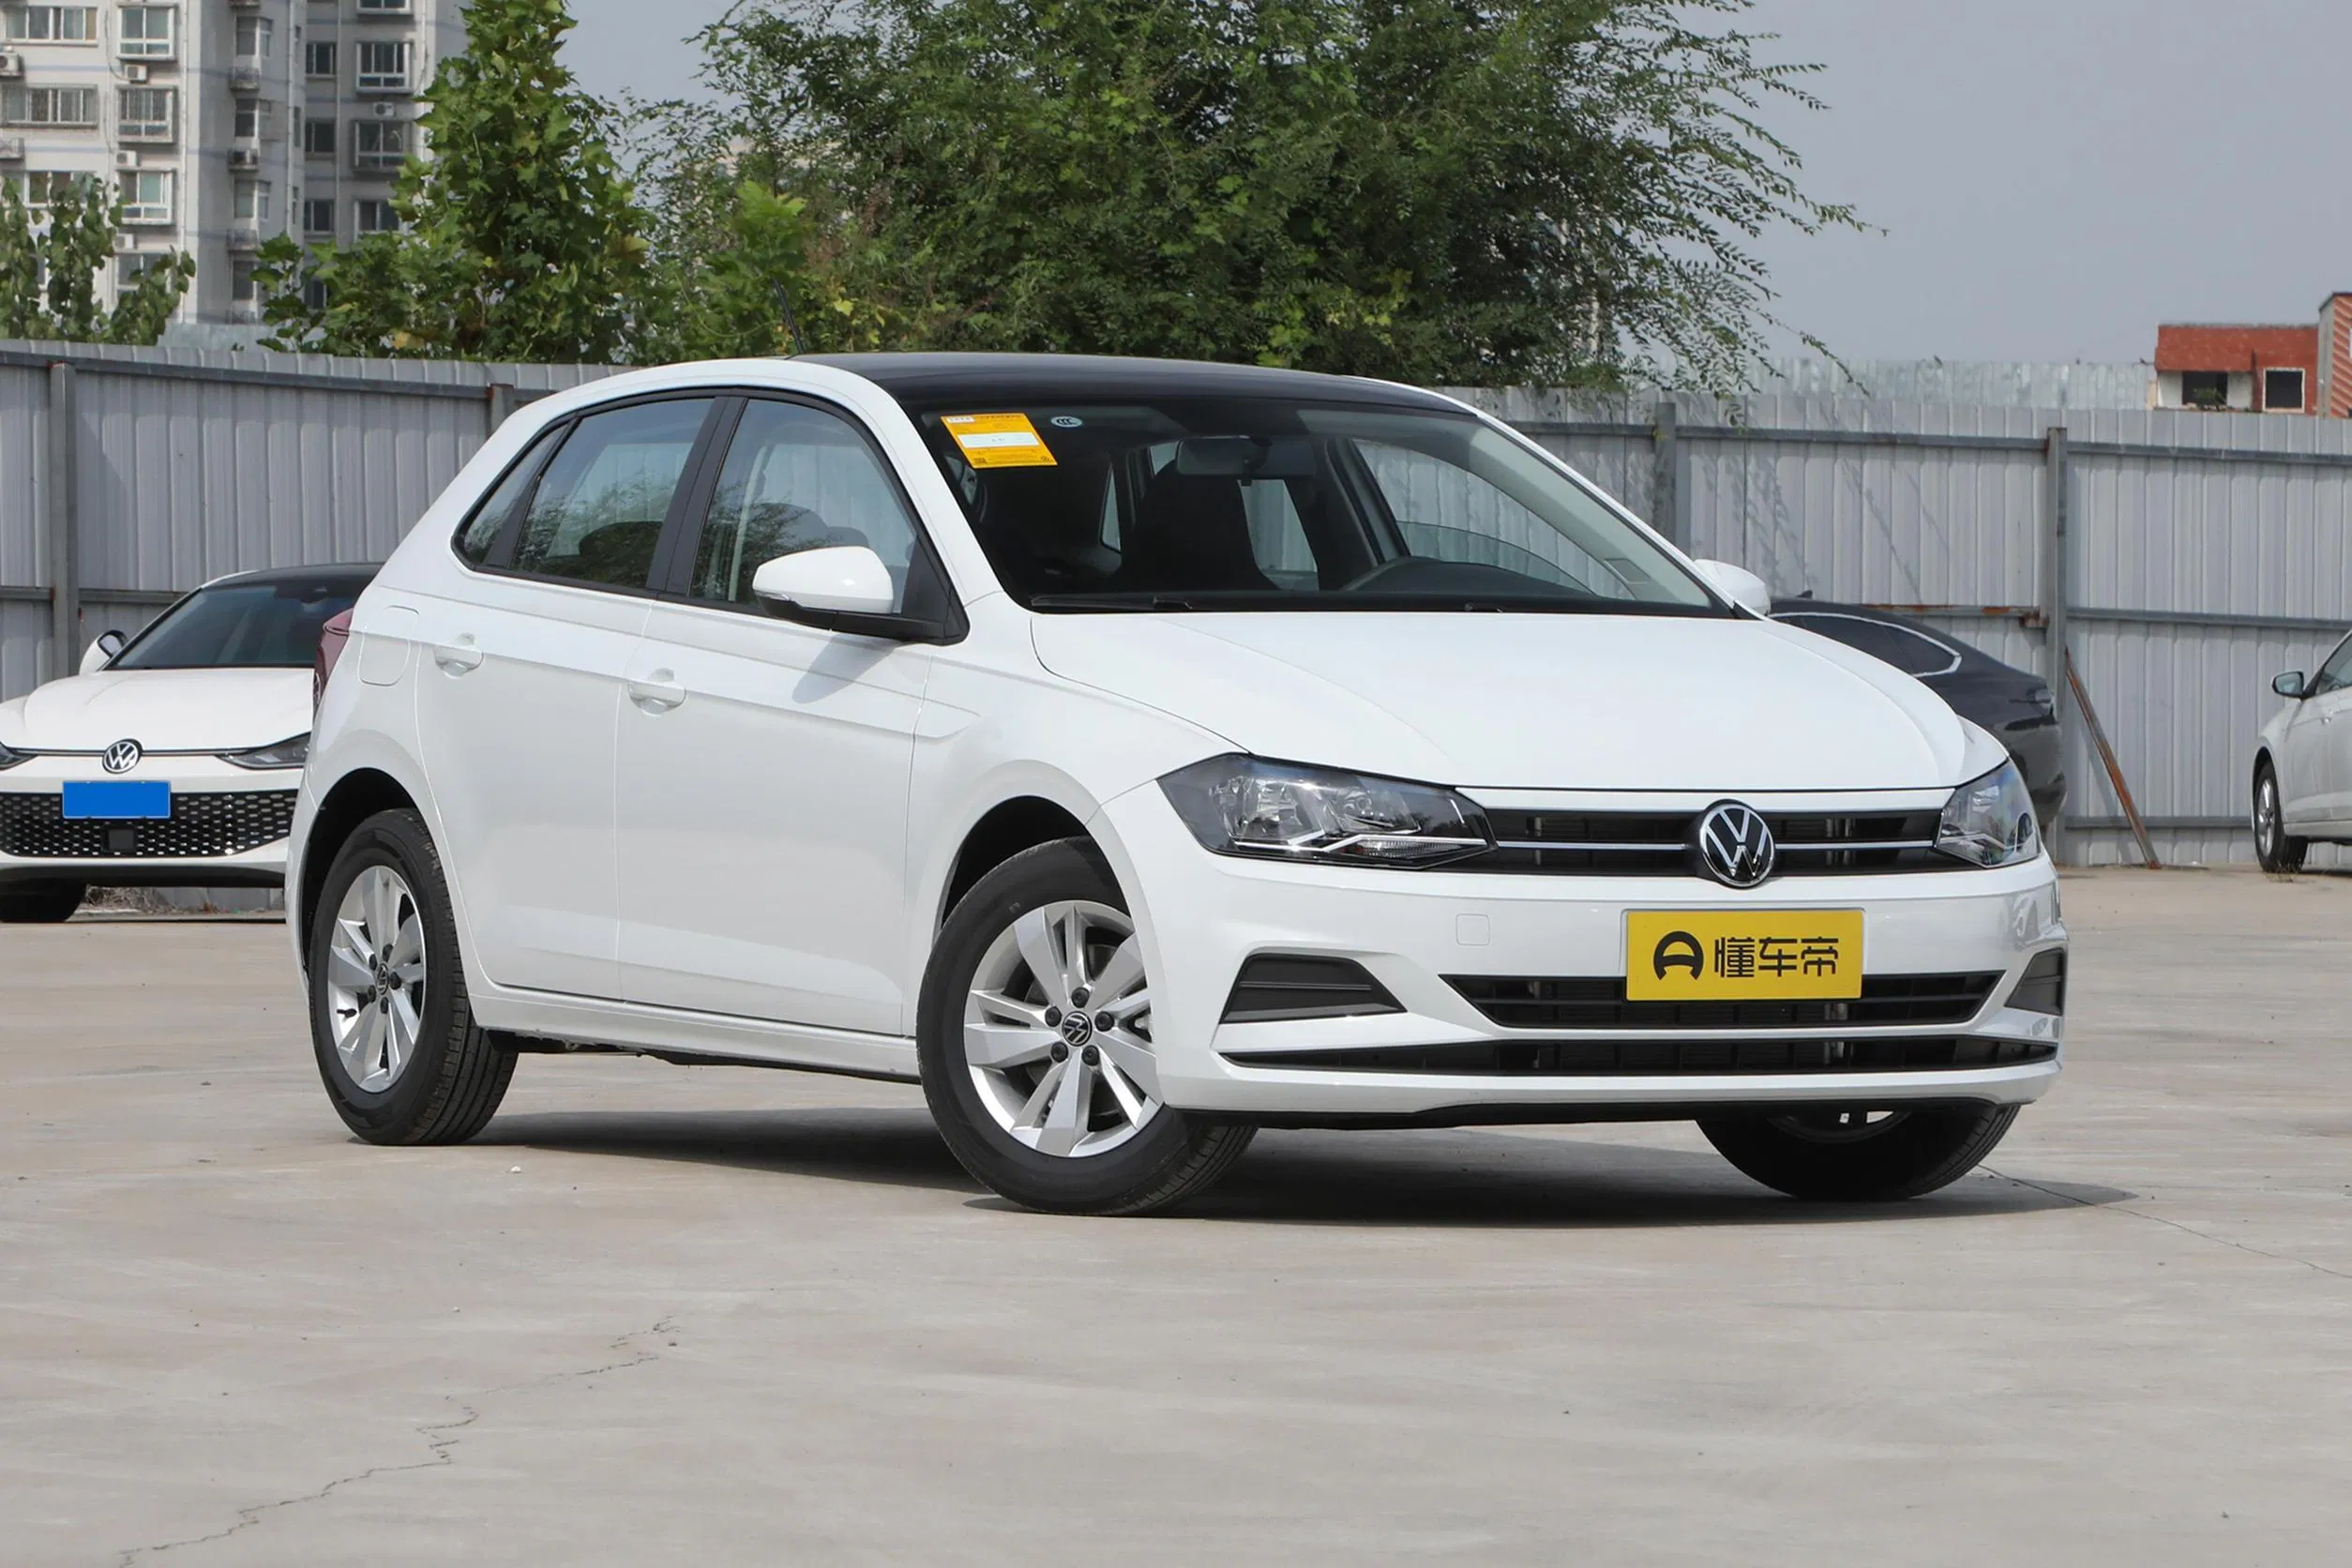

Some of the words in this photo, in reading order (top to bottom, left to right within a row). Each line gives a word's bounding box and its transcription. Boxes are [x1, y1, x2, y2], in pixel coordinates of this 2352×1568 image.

[104, 741, 140, 772] VW
[1702, 804, 1772, 884] VW
[1714, 936, 1839, 978] 懂车帝
